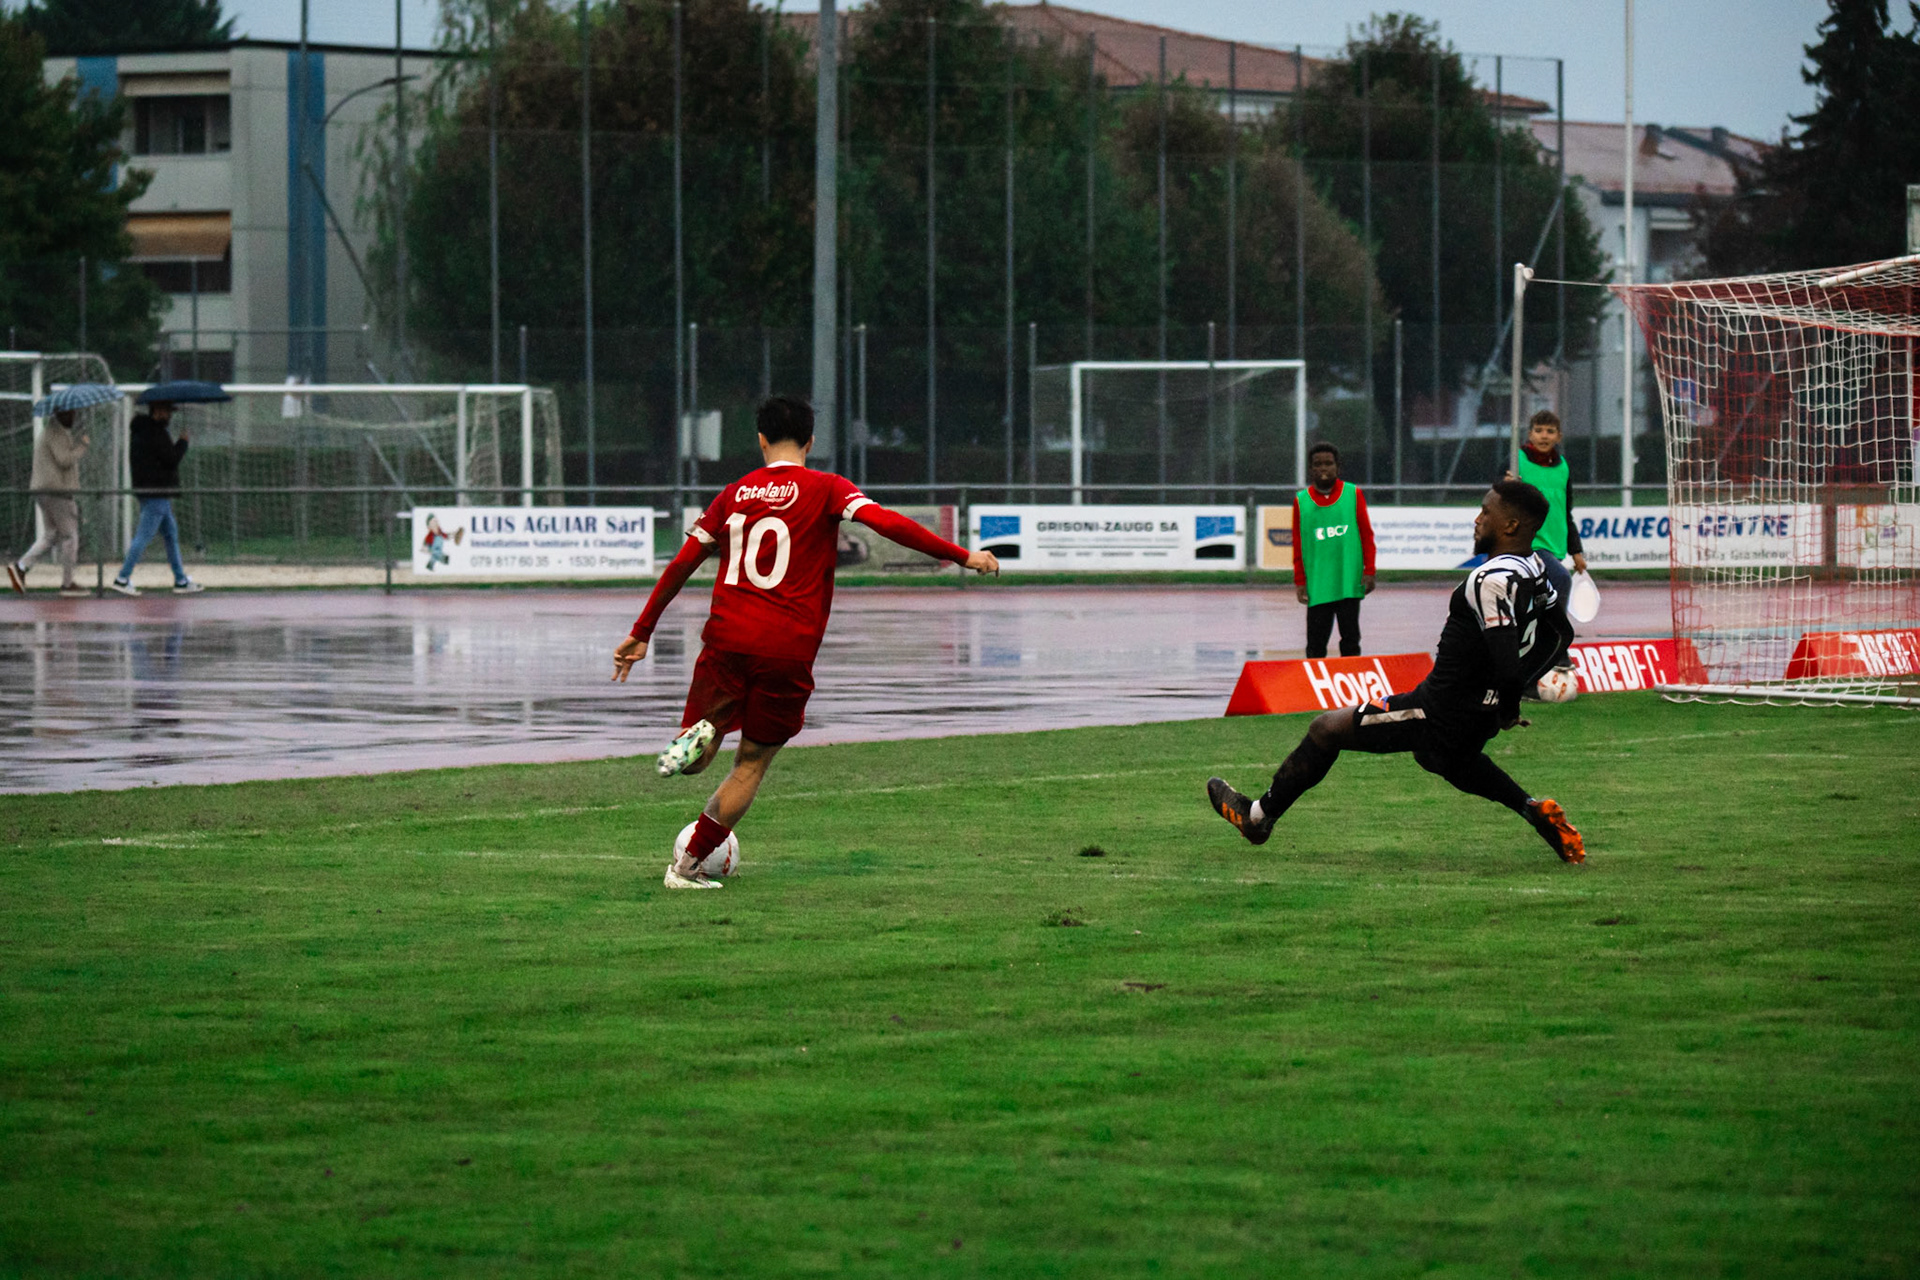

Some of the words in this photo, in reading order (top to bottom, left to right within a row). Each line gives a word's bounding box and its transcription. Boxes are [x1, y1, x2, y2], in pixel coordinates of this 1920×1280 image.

[471, 516, 515, 533] LUIS
[524, 516, 597, 533] AGUIAR
[606, 516, 645, 533] Sàrl
[1036, 521, 1154, 532] GRISONI-ZAUGG
[1159, 521, 1179, 532] SA
[1580, 516, 1670, 539] BALNEO
[724, 512, 791, 590] 10
[471, 555, 492, 567] 079
[570, 555, 596, 567] 1530
[600, 555, 646, 570] Payerne
[1303, 658, 1395, 709] Hoval
